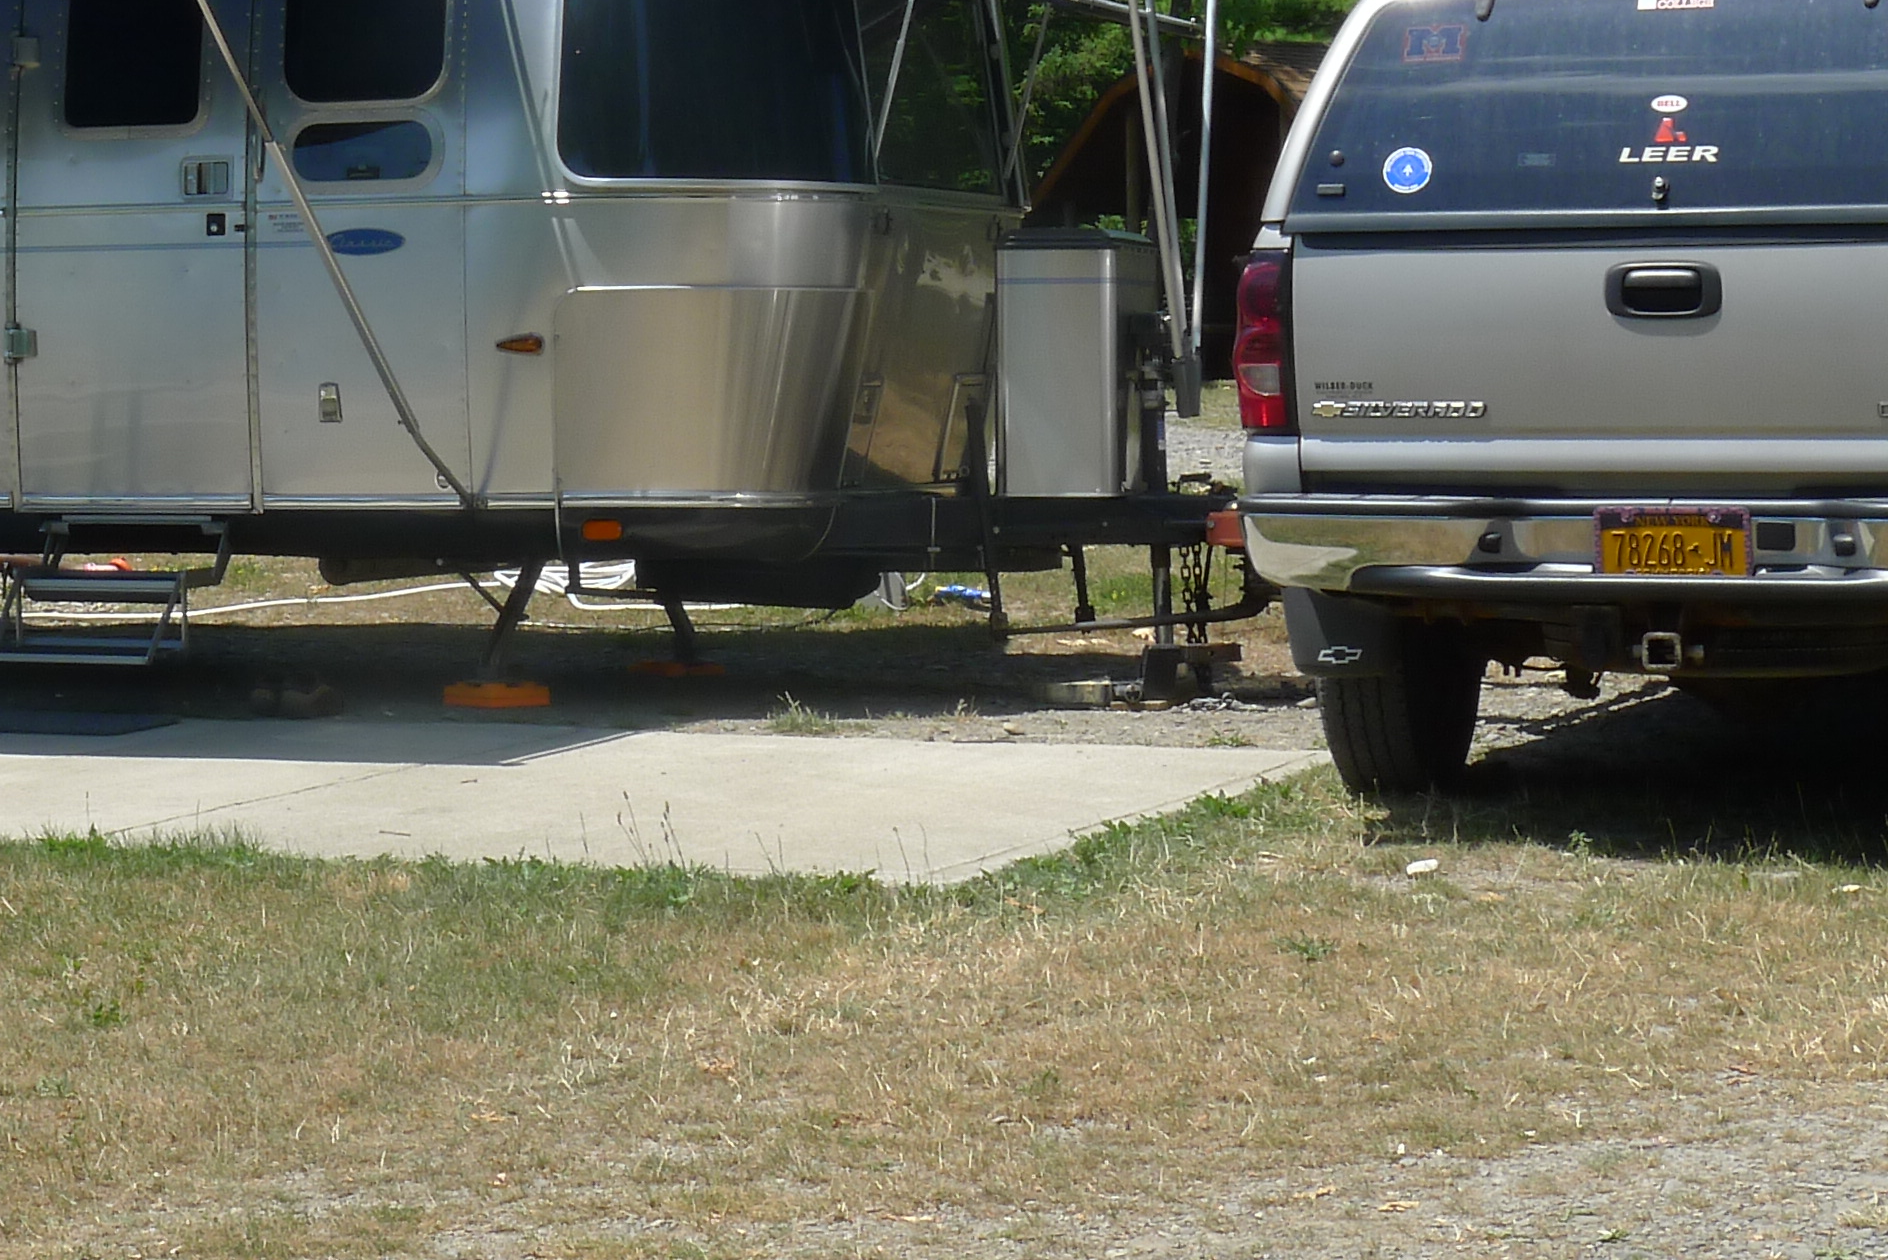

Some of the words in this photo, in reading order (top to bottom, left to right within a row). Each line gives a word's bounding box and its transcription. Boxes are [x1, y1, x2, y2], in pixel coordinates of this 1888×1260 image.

[1618, 145, 1719, 163] LEER
[1342, 400, 1487, 419] SILVERADO
[1634, 515, 1669, 526] NEW
[1674, 514, 1710, 526] YORK
